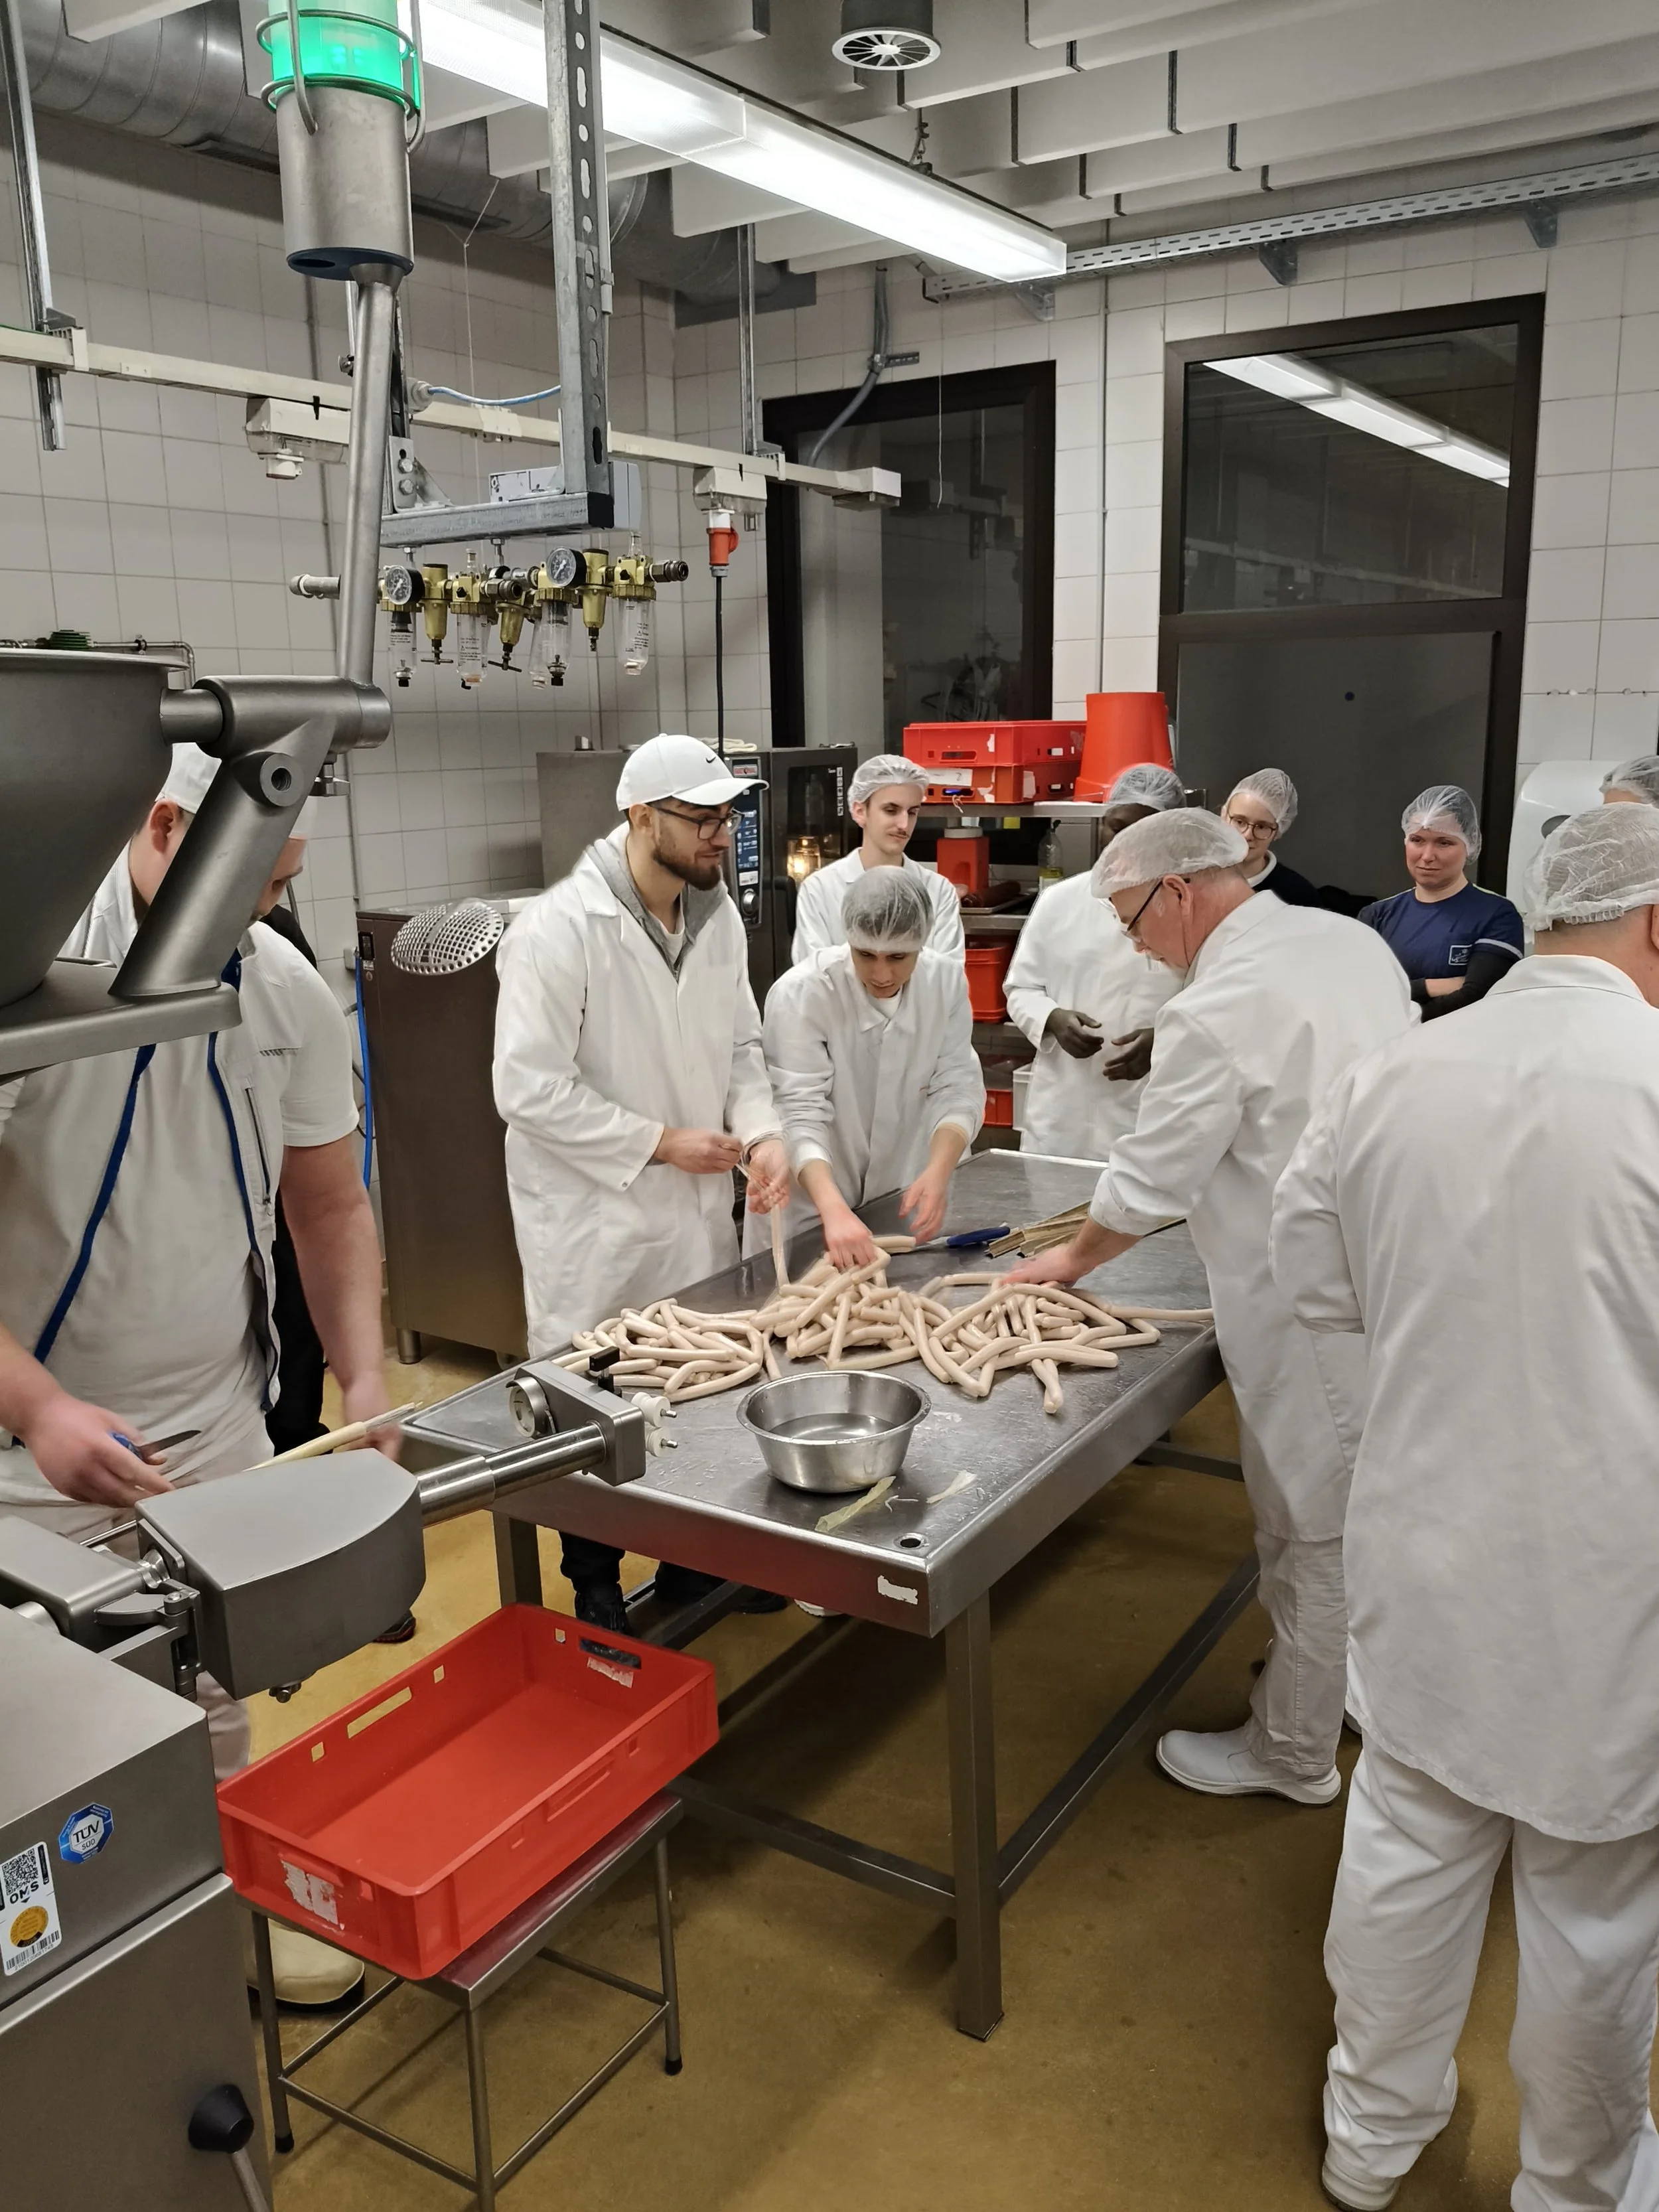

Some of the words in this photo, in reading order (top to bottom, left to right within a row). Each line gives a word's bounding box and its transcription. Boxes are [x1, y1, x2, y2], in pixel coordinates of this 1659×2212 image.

[72, 1820, 100, 1844] TÜV
[82, 1838, 96, 1851] SÜD
[9, 1880, 39, 1904] OMS
